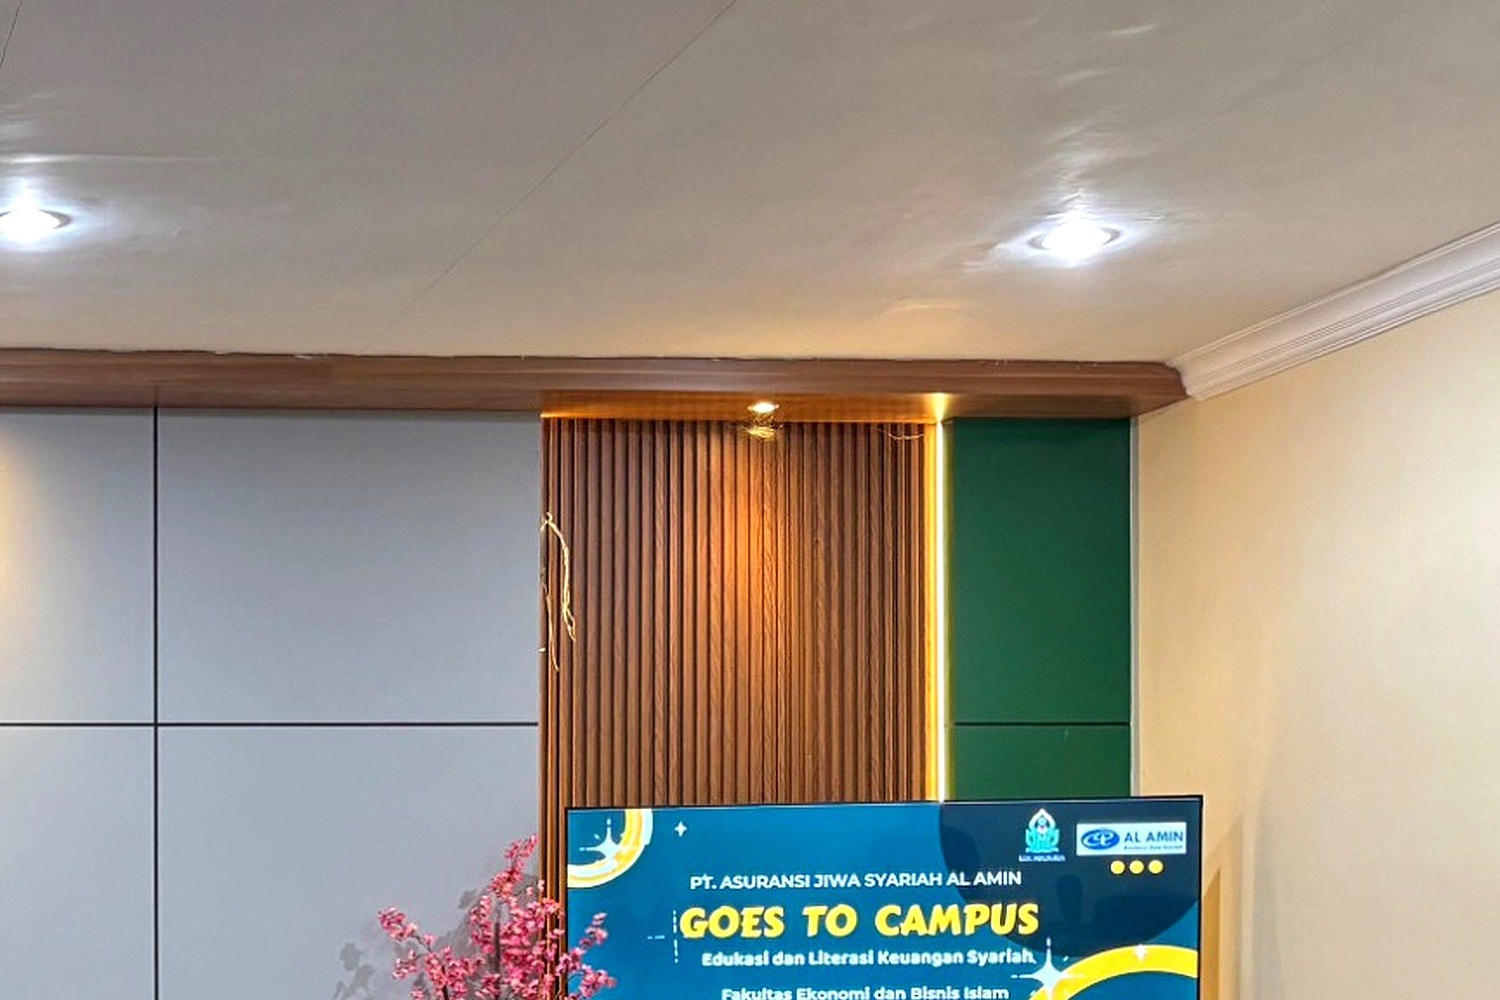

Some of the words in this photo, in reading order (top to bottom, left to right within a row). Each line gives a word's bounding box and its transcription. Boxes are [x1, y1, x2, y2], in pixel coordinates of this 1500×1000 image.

[1124, 832, 1141, 843] AL
[1145, 831, 1184, 843] AMIN
[690, 874, 717, 889] PT.
[719, 874, 810, 889] ASURANSI
[813, 874, 861, 889] JIWA
[864, 872, 942, 887] SYARIAH
[946, 872, 971, 886] AL
[973, 871, 1022, 886] AMIN
[679, 905, 785, 938] GOES
[802, 903, 857, 938] TO
[874, 903, 1039, 937] CAMPUS
[702, 949, 769, 966] Edukasi
[772, 951, 805, 966] dan
[808, 949, 874, 966] Literasi
[877, 949, 964, 968] Keuangan
[967, 948, 1035, 967] Syariah
[721, 987, 792, 1000] Fakultas
[796, 986, 870, 1000] Ekonomi
[873, 986, 906, 1000] dan
[910, 985, 960, 1000] Bisnis
[964, 986, 1009, 999] Islam
